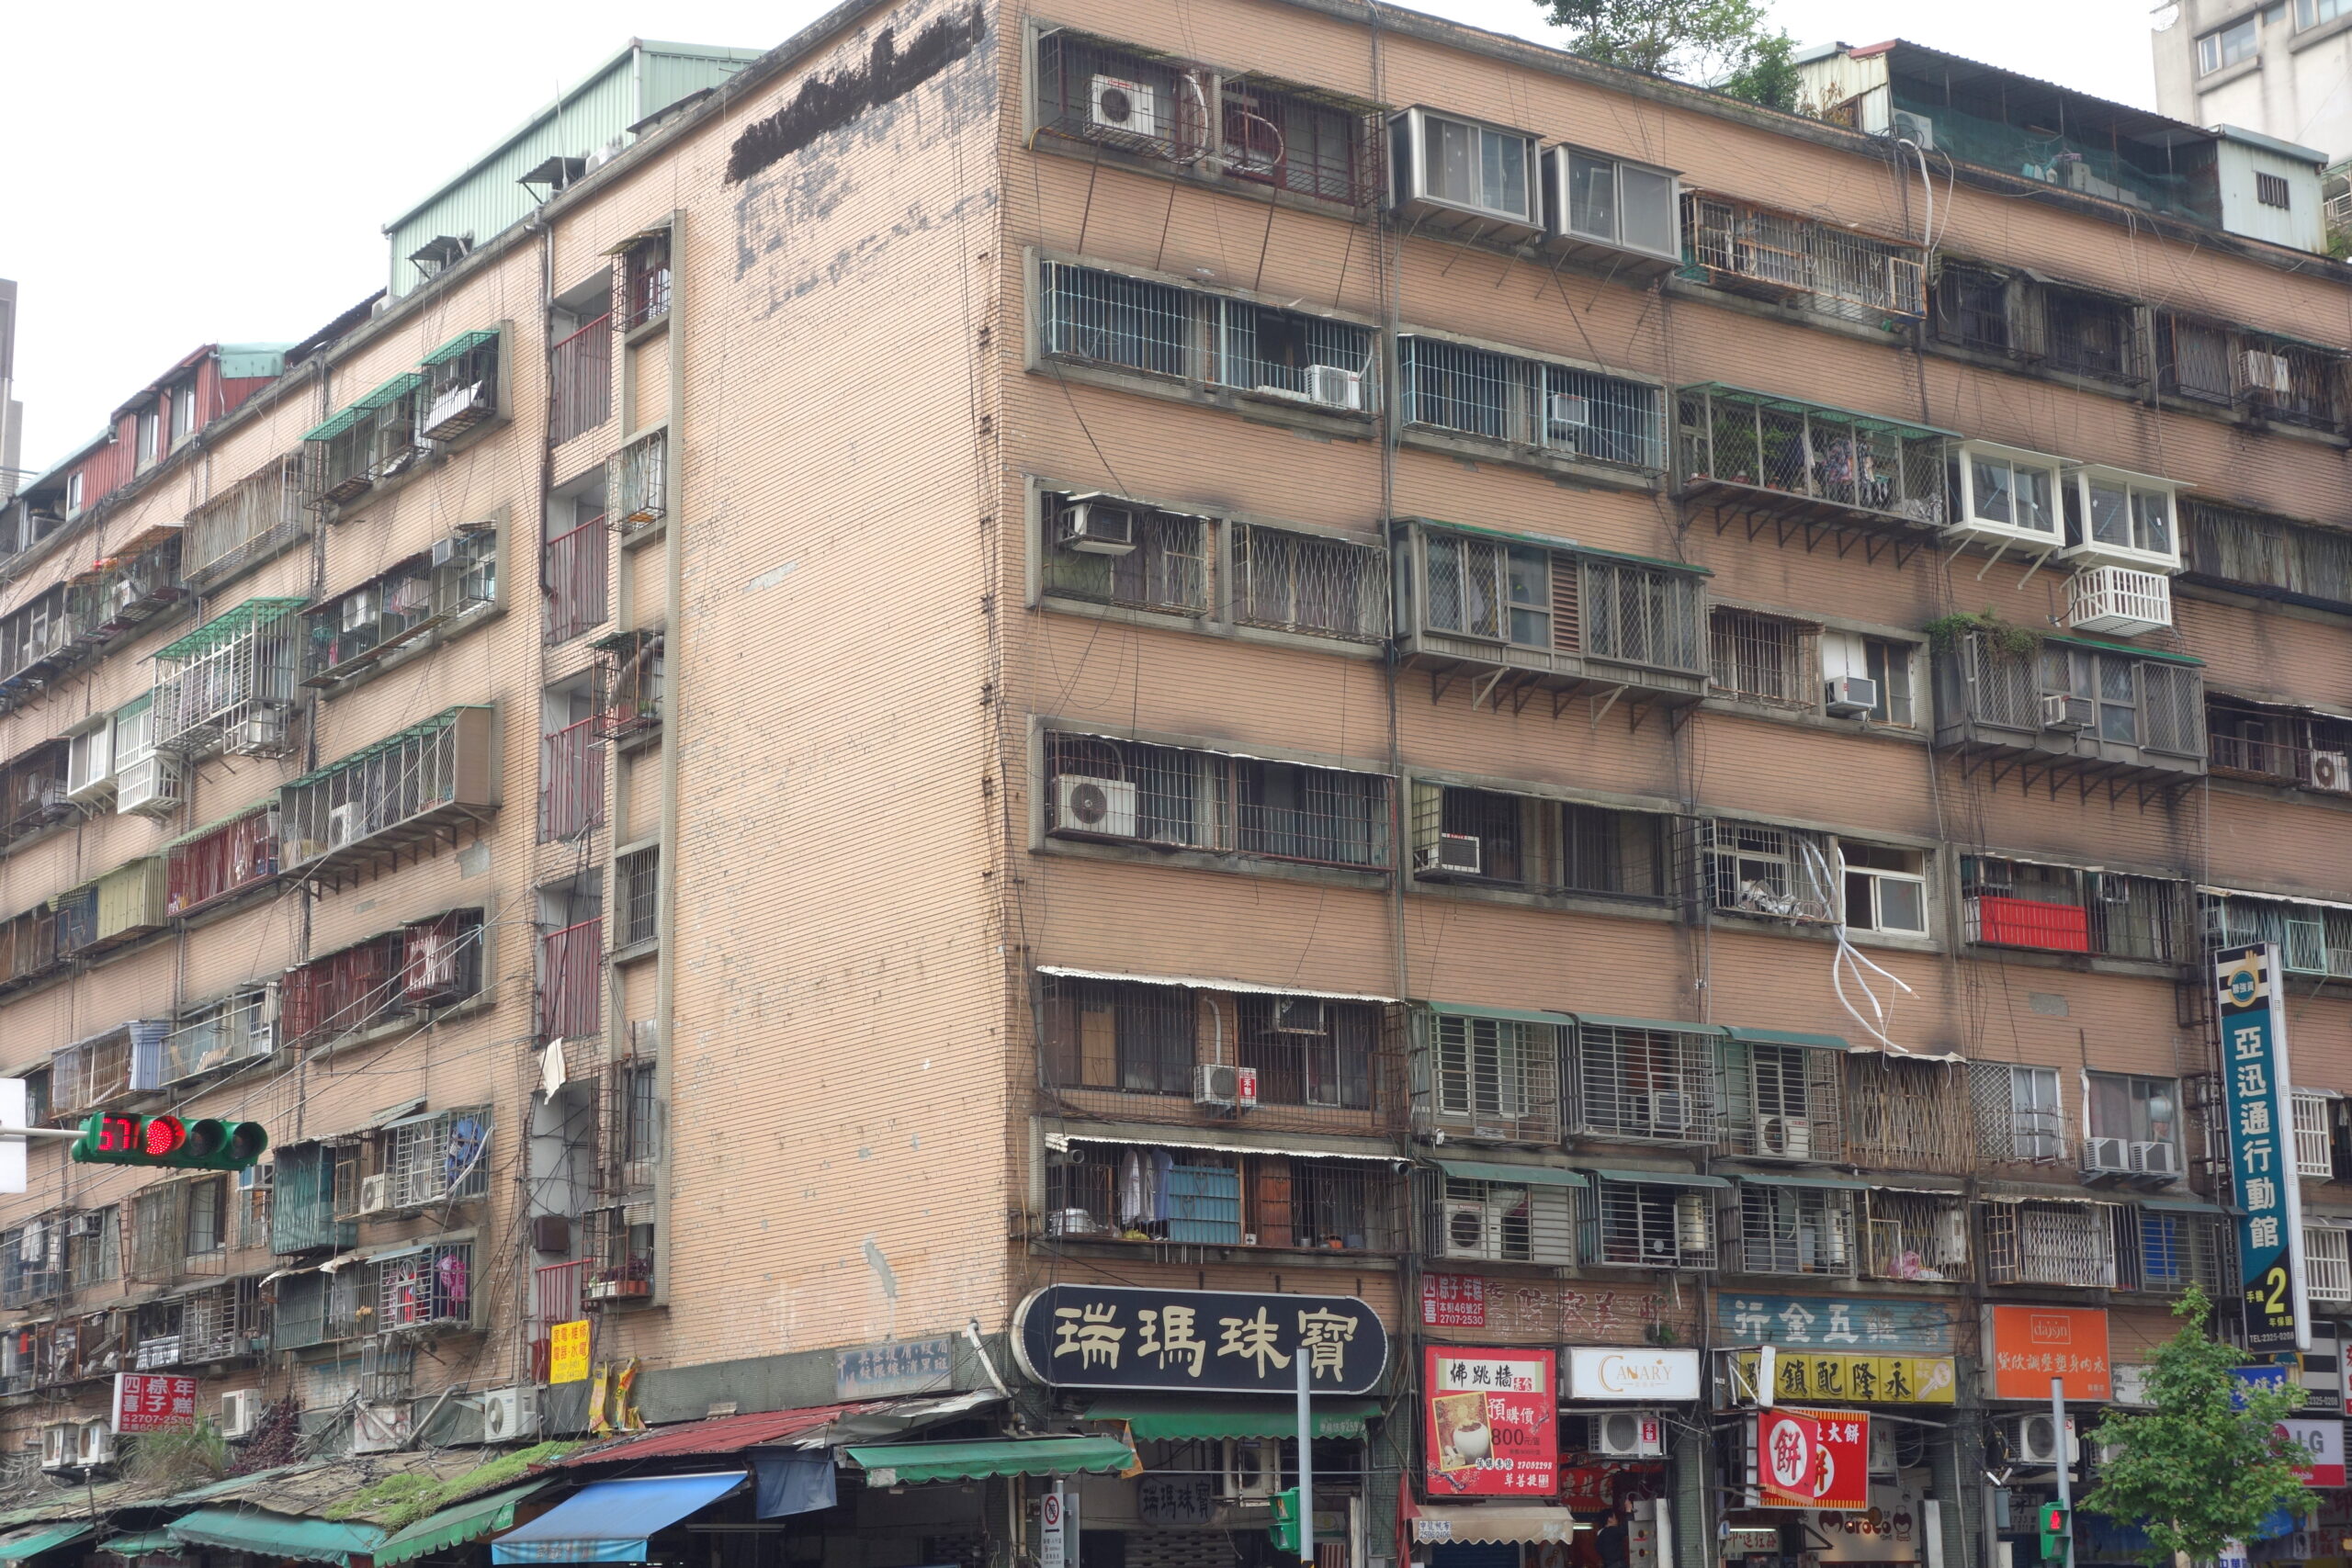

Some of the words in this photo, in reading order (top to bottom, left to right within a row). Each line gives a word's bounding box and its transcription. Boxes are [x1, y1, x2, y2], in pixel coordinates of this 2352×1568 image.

[2234, 1025, 2279, 1249] 亞迅通行動館
[1423, 1274, 1437, 1323] 四喜
[1440, 1314, 1484, 1325] 2707-2530
[1054, 1302, 1359, 1383] 瑞瑪珠寶
[1450, 1361, 1513, 1388] 佛跳牆
[1599, 1355, 1672, 1392] CANARY
[123, 1376, 140, 1412] 四喜
[1487, 1397, 1534, 1425] 預購價
[1774, 1427, 1802, 1481] 餅
[2298, 1430, 2324, 1454] LG
